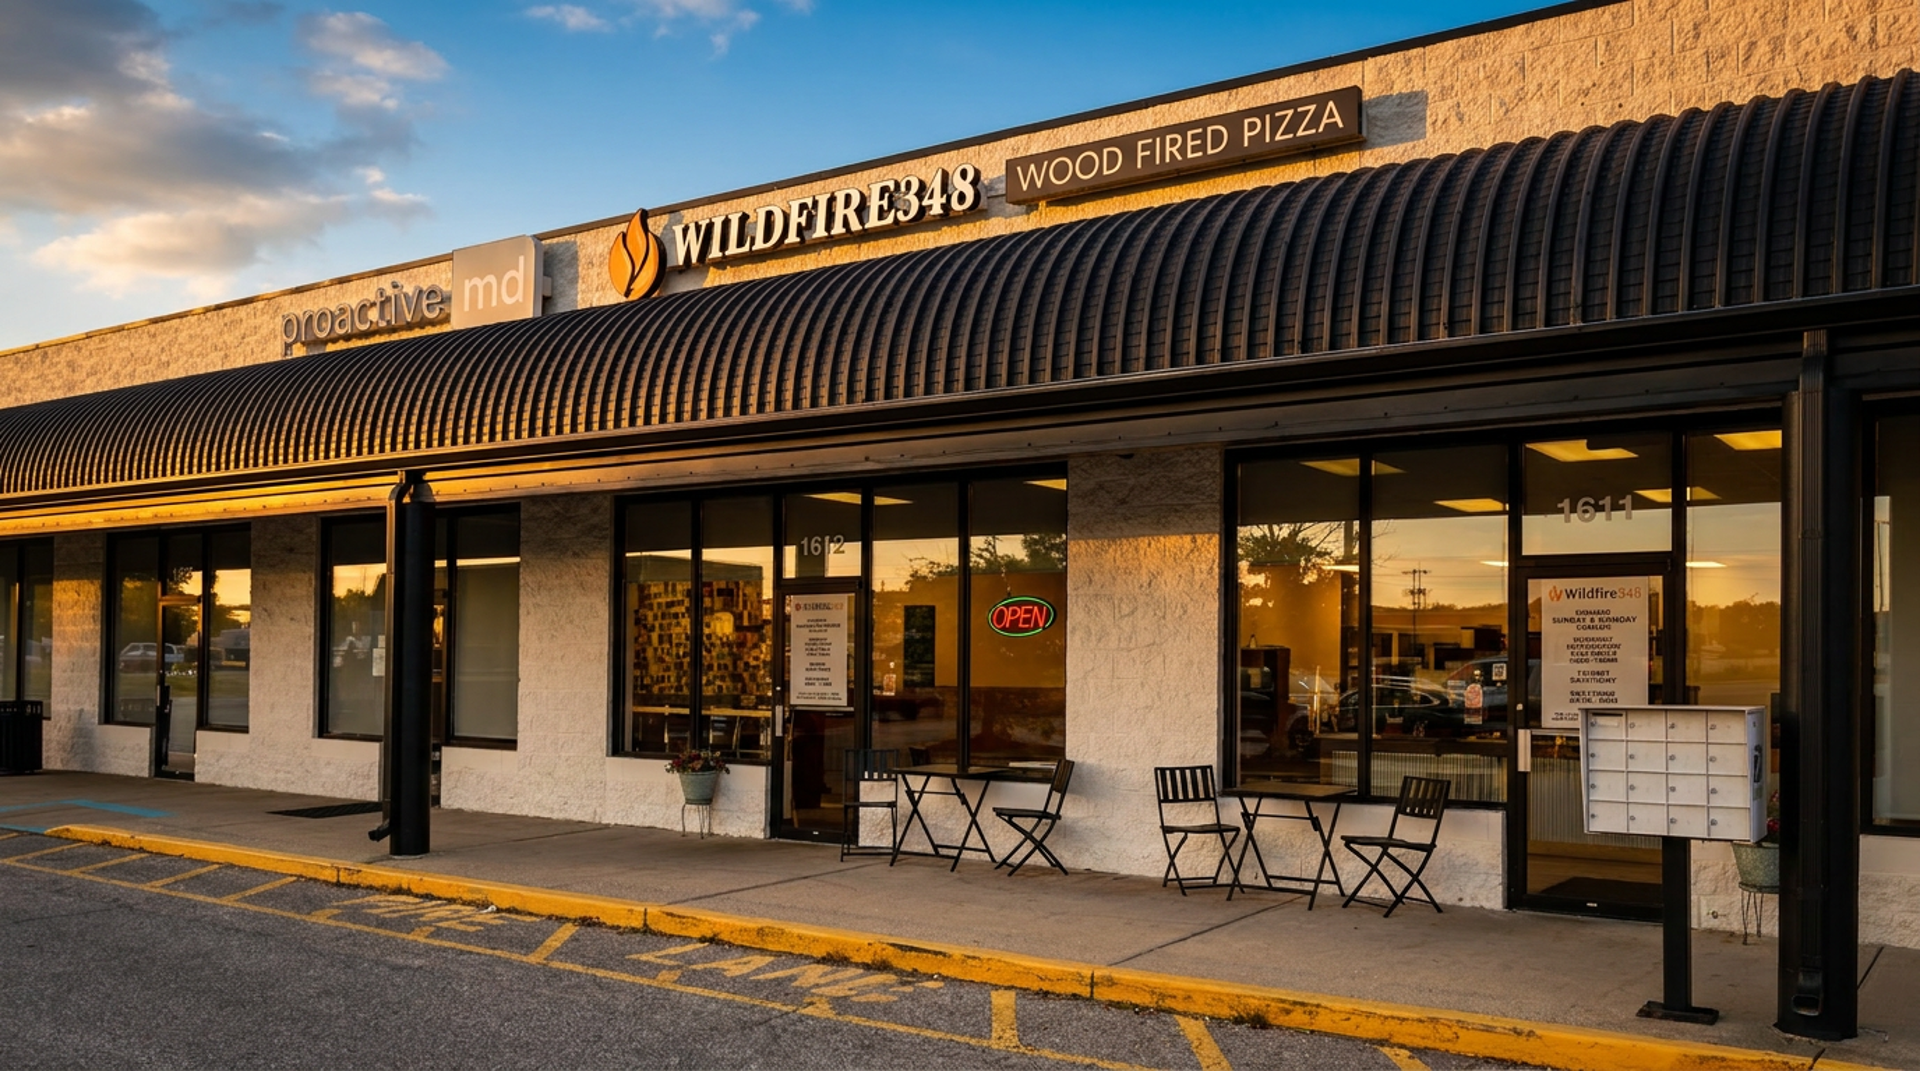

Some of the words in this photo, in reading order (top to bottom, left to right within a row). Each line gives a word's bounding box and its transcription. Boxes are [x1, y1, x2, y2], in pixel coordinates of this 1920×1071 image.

[1016, 147, 1123, 191] WOOD
[1137, 125, 1229, 169] FIRED
[1243, 99, 1344, 147] PIZZA
[673, 162, 980, 266] WILDFIRE348
[281, 280, 446, 357] proactive
[463, 255, 525, 312] md
[1556, 494, 1633, 524] 1611
[800, 534, 845, 556] 1612
[1564, 586, 1642, 600] Wildfire348
[992, 605, 1047, 629] OPEN
